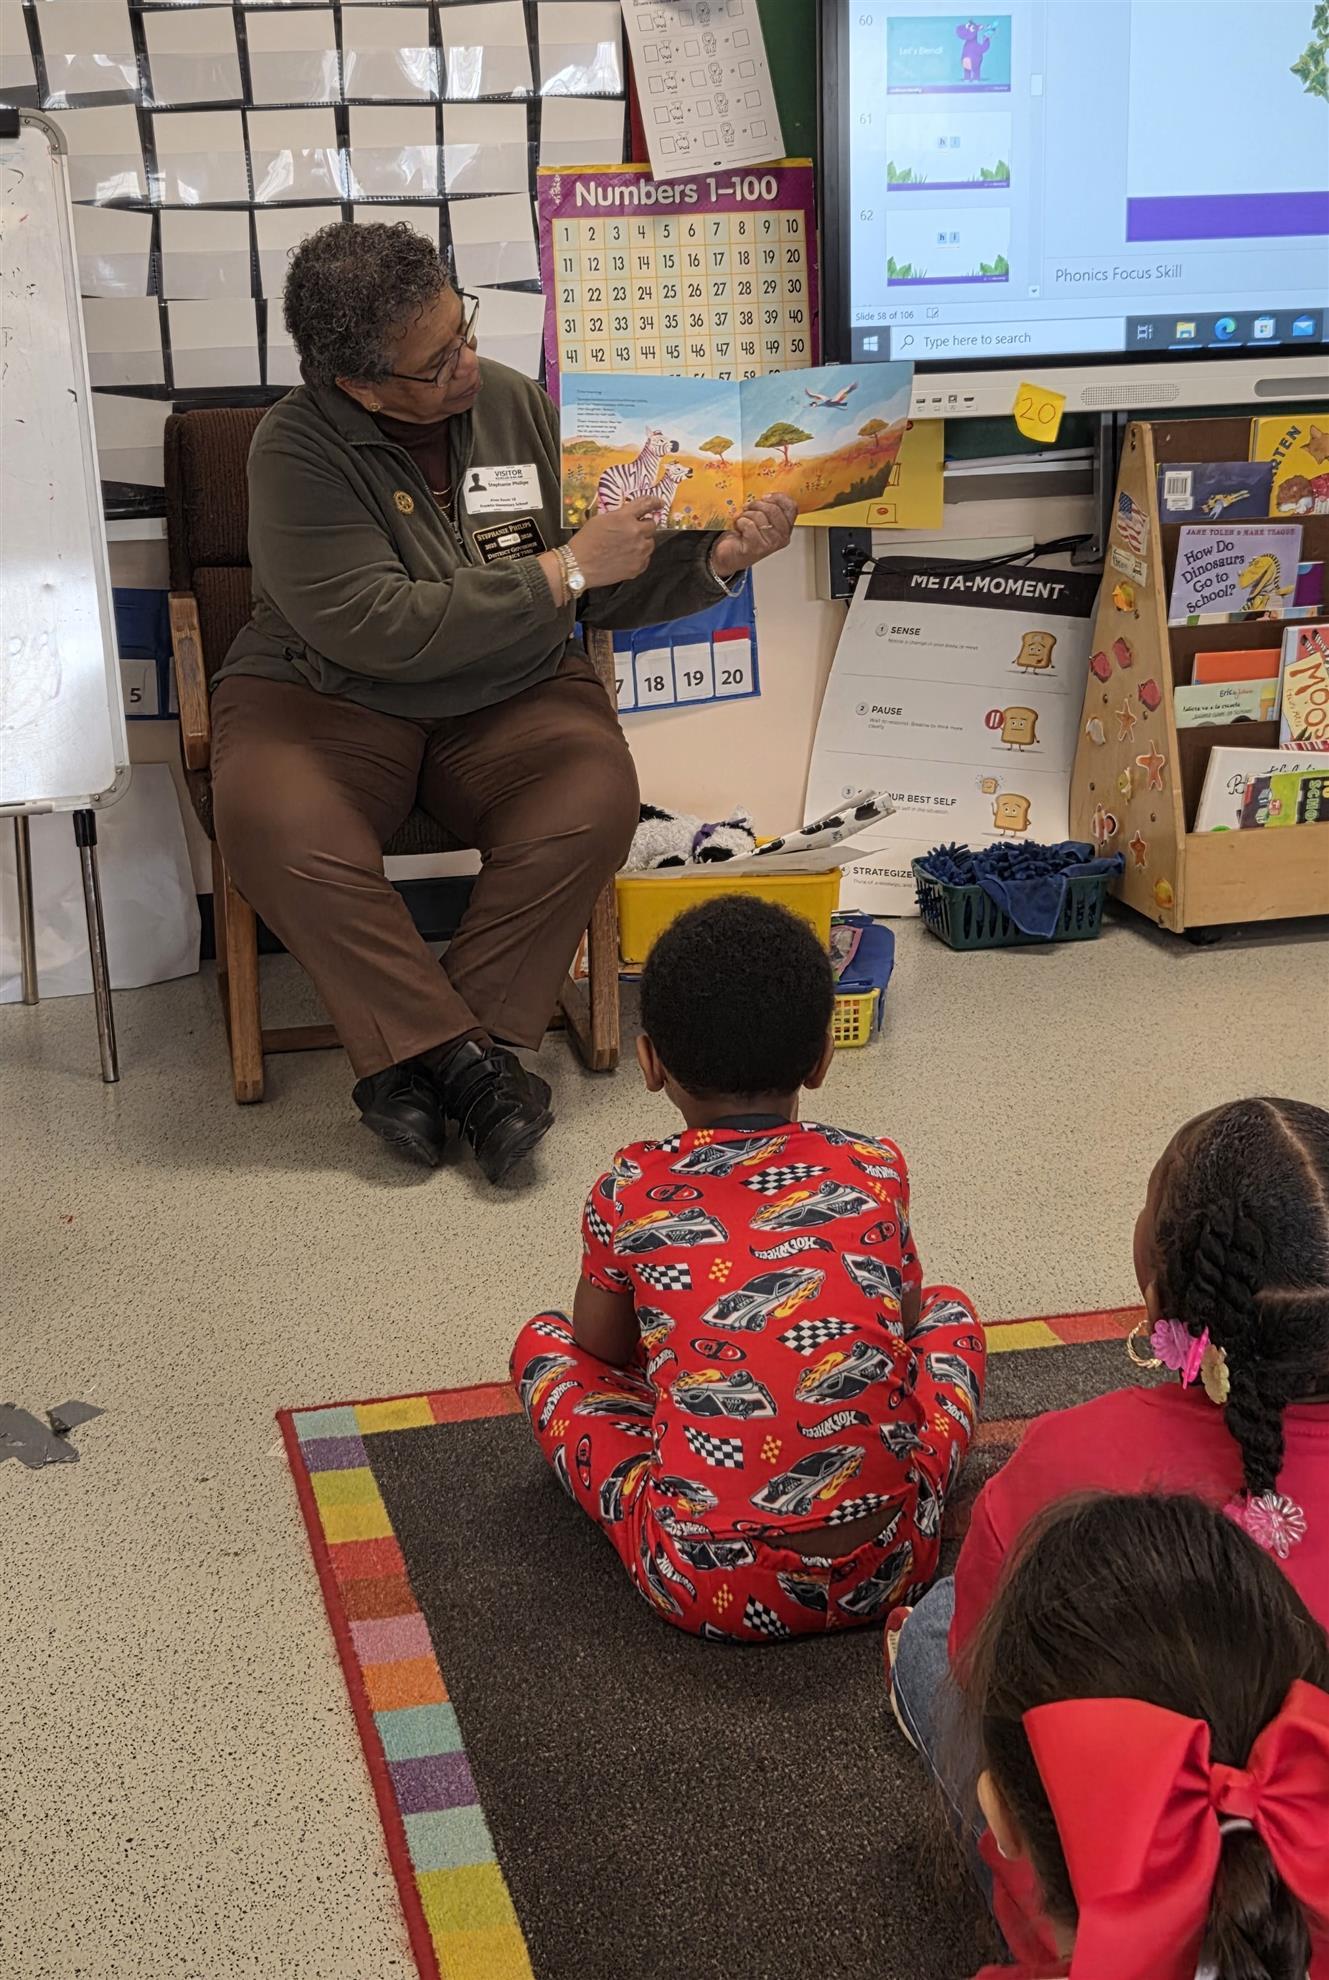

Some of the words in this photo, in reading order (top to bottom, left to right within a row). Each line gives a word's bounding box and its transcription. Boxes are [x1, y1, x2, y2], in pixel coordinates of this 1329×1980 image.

[859, 15, 873, 26] 60
[860, 113, 872, 125] 61
[576, 178, 698, 207] Numbers
[860, 210, 874, 221] 62
[588, 226, 596, 241] 2
[613, 226, 620, 240] 3
[638, 225, 646, 239] 4
[663, 224, 670, 238] 5
[688, 223, 696, 238] 6
[713, 222, 720, 236] 7
[738, 220, 746, 235] 8
[763, 220, 771, 234] 9
[786, 219, 798, 233] 10
[563, 258, 573, 272] 11
[587, 257, 600, 272] 12
[612, 256, 625, 271] 13
[637, 256, 650, 270] 14
[663, 254, 675, 268] 15
[687, 253, 700, 267] 16
[713, 252, 725, 266] 17
[738, 250, 750, 265] 18
[763, 250, 775, 264] 19
[786, 249, 800, 263] 20
[1056, 267, 1108, 282] Phonics
[1113, 266, 1151, 280] Focus
[1155, 264, 1182, 279] Skill
[563, 288, 575, 303] 21
[587, 288, 602, 302] 22
[612, 286, 627, 301] 23
[637, 286, 652, 300] 24
[663, 284, 677, 299] 25
[688, 283, 702, 298] 26
[713, 282, 727, 296] 27
[738, 280, 752, 295] 28
[763, 280, 777, 294] 29
[787, 279, 802, 294] 30
[565, 319, 576, 333] 31
[589, 317, 604, 332] 32
[614, 316, 629, 331] 33
[639, 316, 654, 330] 34
[665, 314, 679, 329] 35
[689, 313, 704, 328] 36
[715, 312, 728, 326] 37
[739, 311, 753, 326] 38
[764, 309, 778, 324] 39
[789, 309, 803, 323] 40
[856, 312, 875, 321] Slide
[877, 311, 887, 320] 58
[889, 311, 898, 319] of
[900, 310, 914, 319] 106
[566, 350, 578, 363] 41
[591, 348, 605, 362] 42
[616, 346, 630, 361] 43
[640, 346, 656, 360] 44
[666, 344, 680, 359] 45
[691, 344, 706, 358] 46
[716, 342, 730, 356] 47
[741, 341, 755, 355] 48
[765, 340, 780, 354] 49
[791, 338, 804, 353] 50
[924, 336, 950, 349] Type
[952, 335, 978, 346] here
[981, 335, 992, 345] to
[995, 333, 1031, 345] search
[1019, 397, 1056, 424] 20
[495, 469, 522, 477] VISITOR
[1184, 545, 1213, 566] How
[1216, 540, 1235, 554] Do
[1181, 555, 1245, 585] Dinosaurs
[911, 575, 1064, 600] META-MOMENT
[1193, 578, 1213, 593] Go
[1215, 572, 1229, 584] to
[1186, 583, 1236, 614] School?
[890, 626, 921, 636] SENSE
[645, 675, 665, 693] 18
[684, 670, 704, 687] 19
[721, 669, 743, 685] 20
[130, 688, 142, 703] 5
[871, 705, 903, 716] PAUSE
[907, 794, 931, 804] BEST
[933, 797, 957, 806] SELF
[1304, 779, 1322, 823] SCHO
[853, 866, 913, 878] STRATEGIZE
